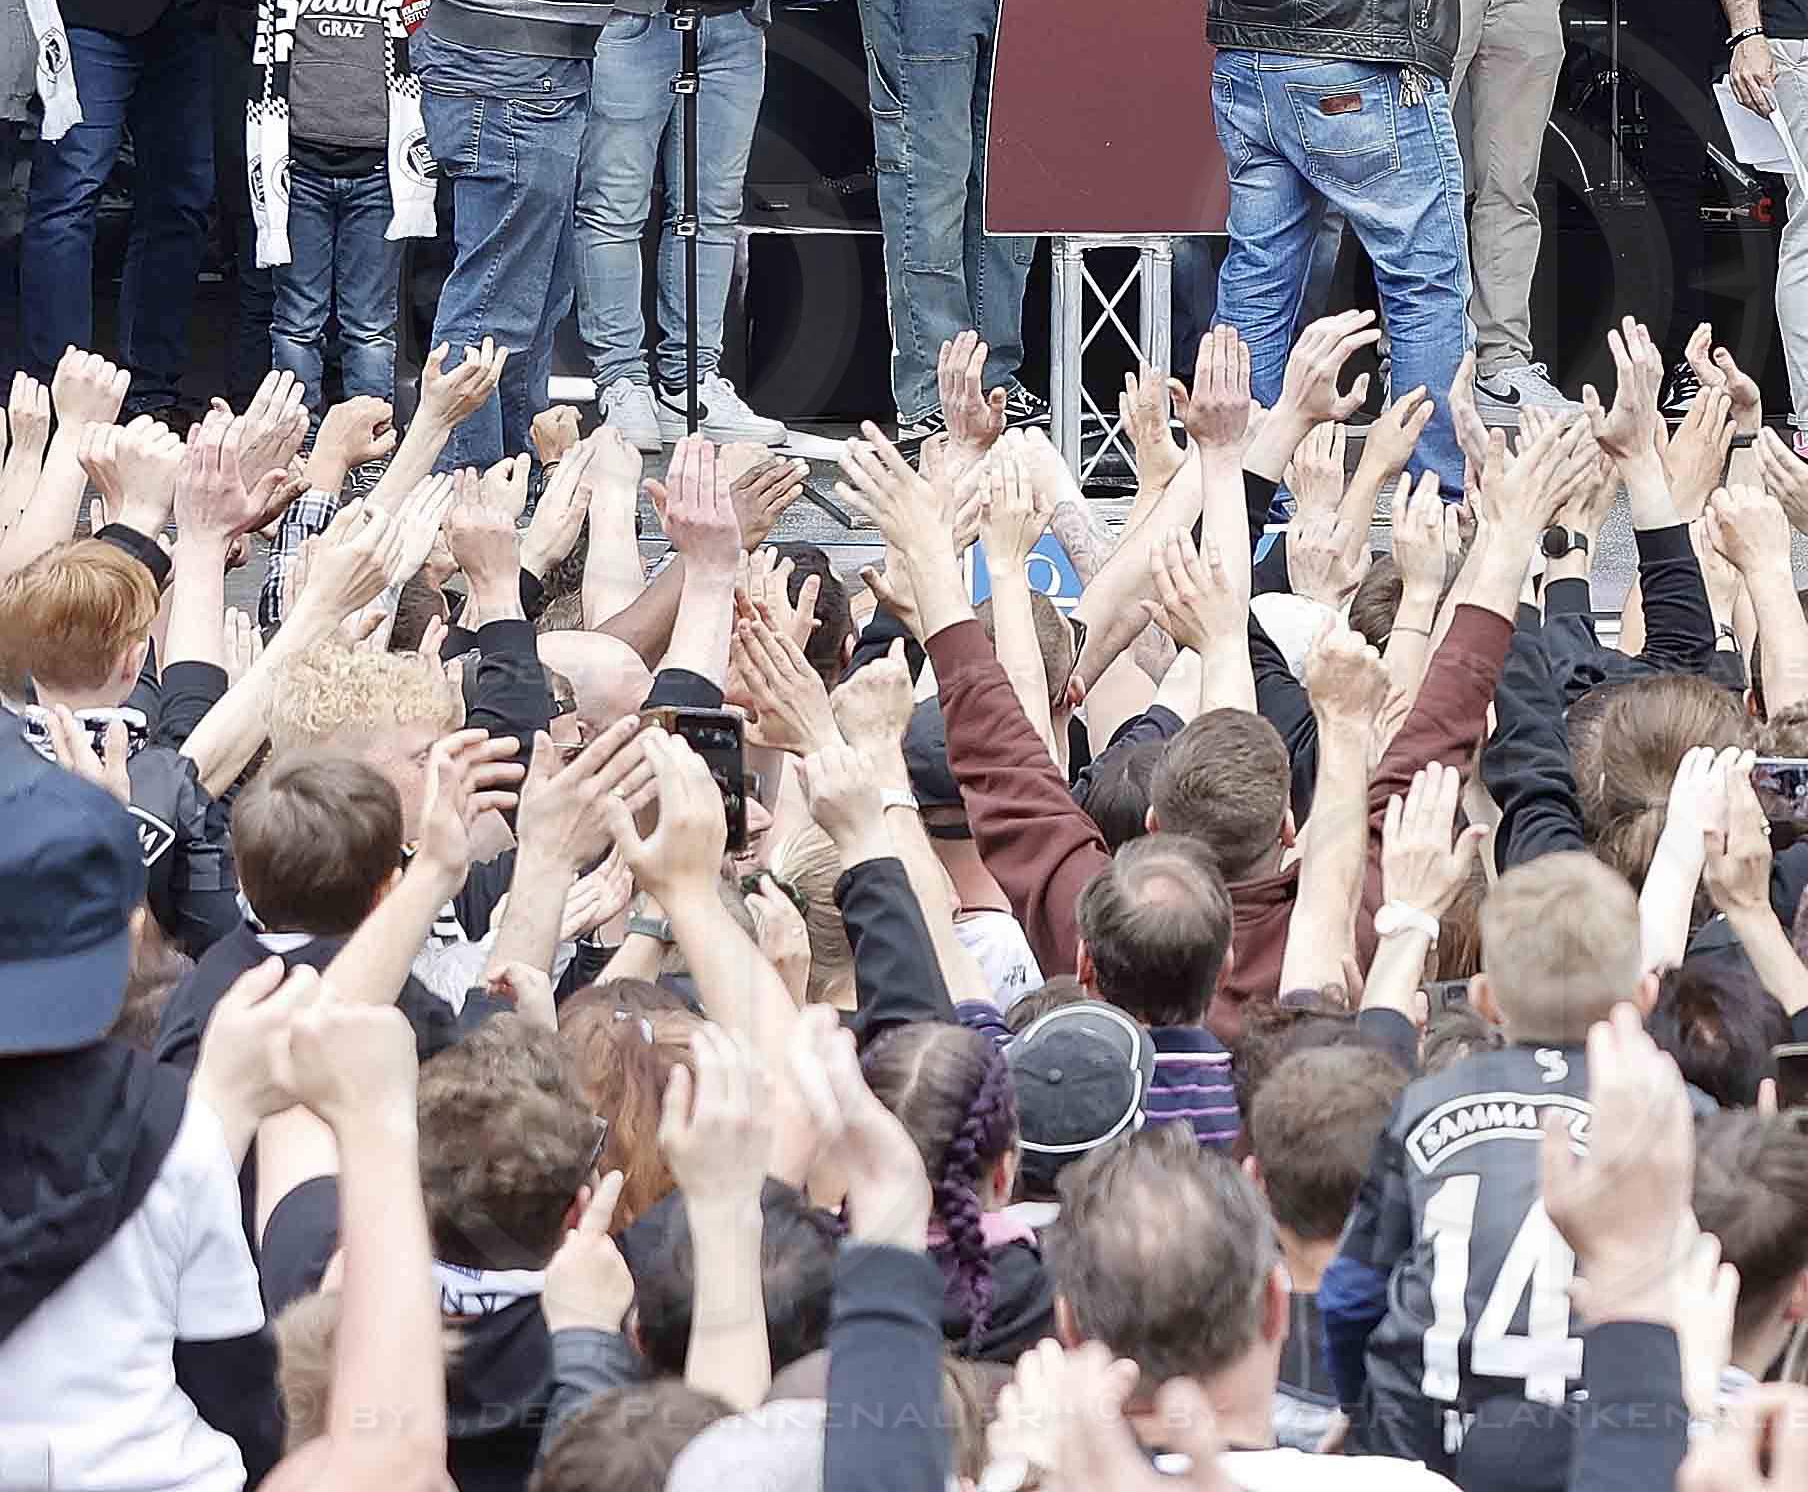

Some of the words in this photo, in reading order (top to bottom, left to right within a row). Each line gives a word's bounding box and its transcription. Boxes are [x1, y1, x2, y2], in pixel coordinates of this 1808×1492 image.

[318, 20, 364, 38] GRAZ
[1421, 1103, 1538, 1157] SAMMA
[1421, 1173, 1586, 1401] 14
